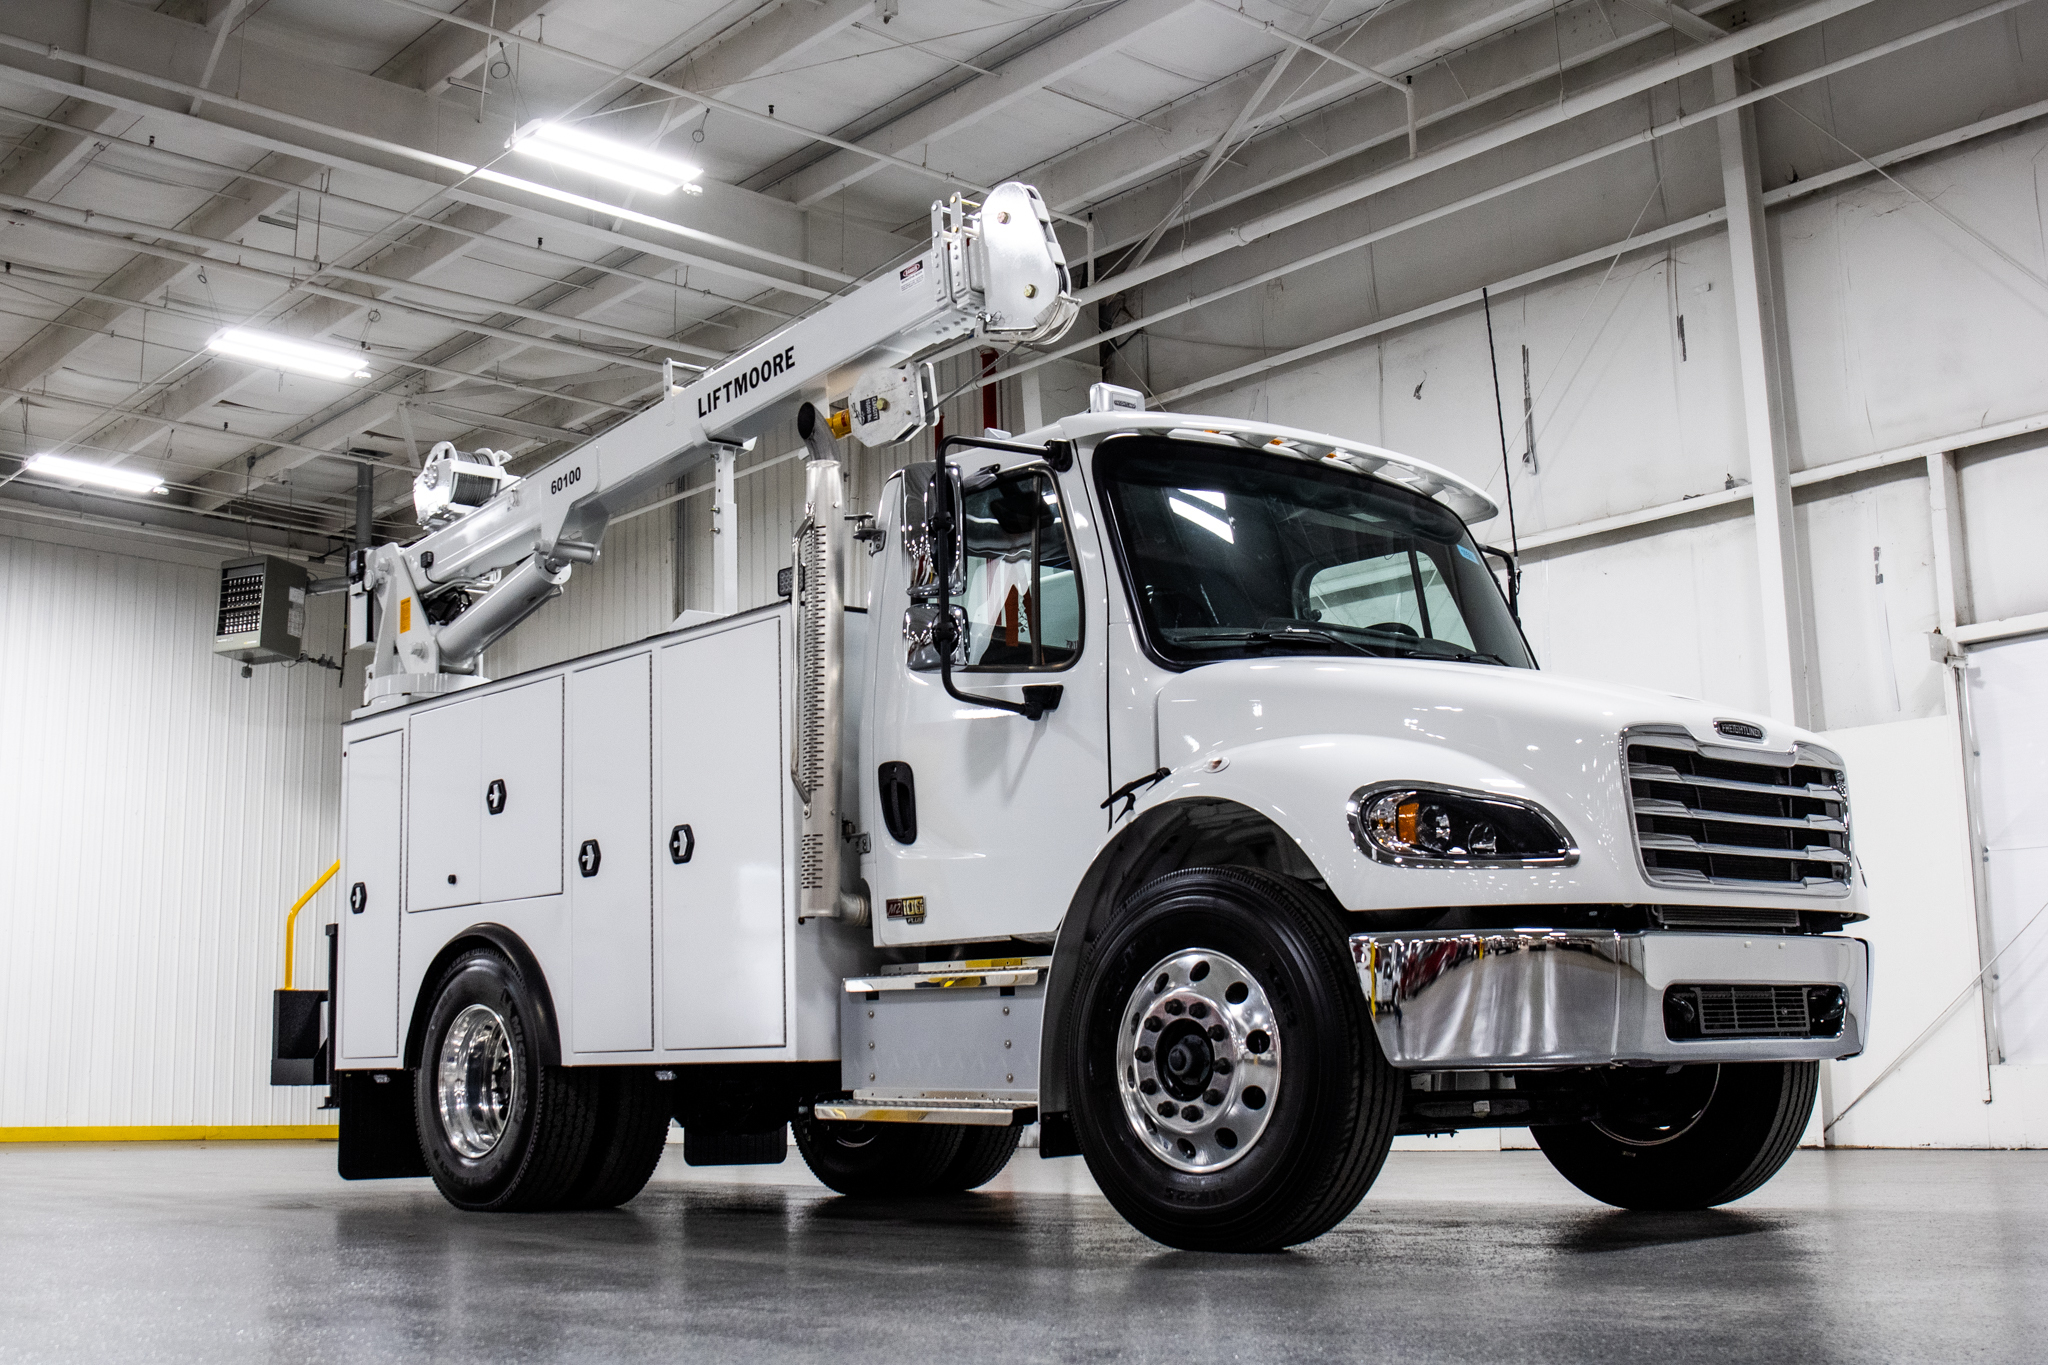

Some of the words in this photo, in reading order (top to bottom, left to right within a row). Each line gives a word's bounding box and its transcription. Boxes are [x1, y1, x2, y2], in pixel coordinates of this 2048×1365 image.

[697, 345, 796, 418] LIFTMOORE
[551, 466, 581, 495] 60100
[889, 903, 901, 914] M2
[903, 898, 924, 915] 106
